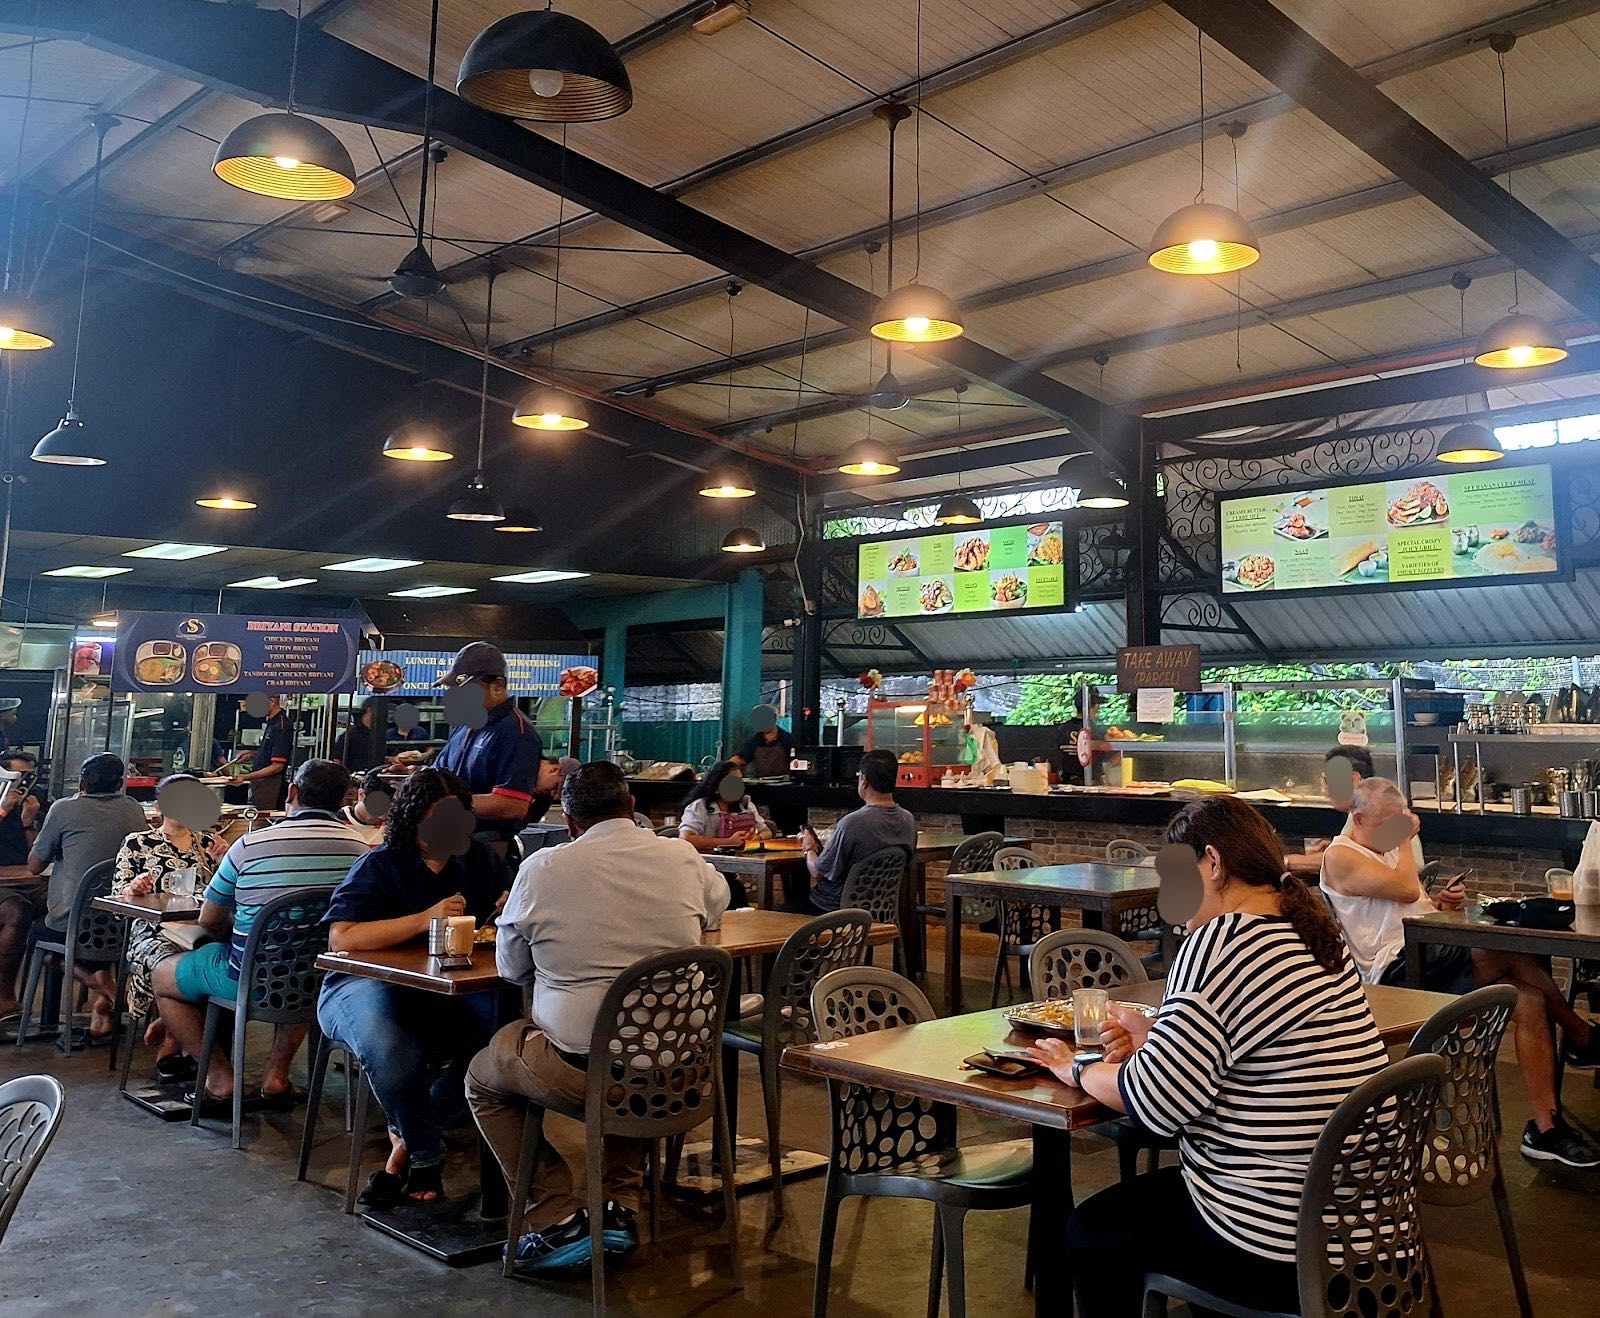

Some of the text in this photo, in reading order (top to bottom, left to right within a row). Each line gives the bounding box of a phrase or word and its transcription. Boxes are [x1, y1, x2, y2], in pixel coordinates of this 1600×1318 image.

[1421, 537, 1441, 545] CRISPY
[186, 618, 199, 634] S
[247, 621, 339, 633] BRIYANI STATION
[405, 657, 437, 665] LUNCH
[438, 657, 446, 665] &
[1124, 651, 1192, 669] TAKE AWAY
[1134, 671, 1180, 687] (PARCEL)
[403, 682, 430, 690] ONCE
